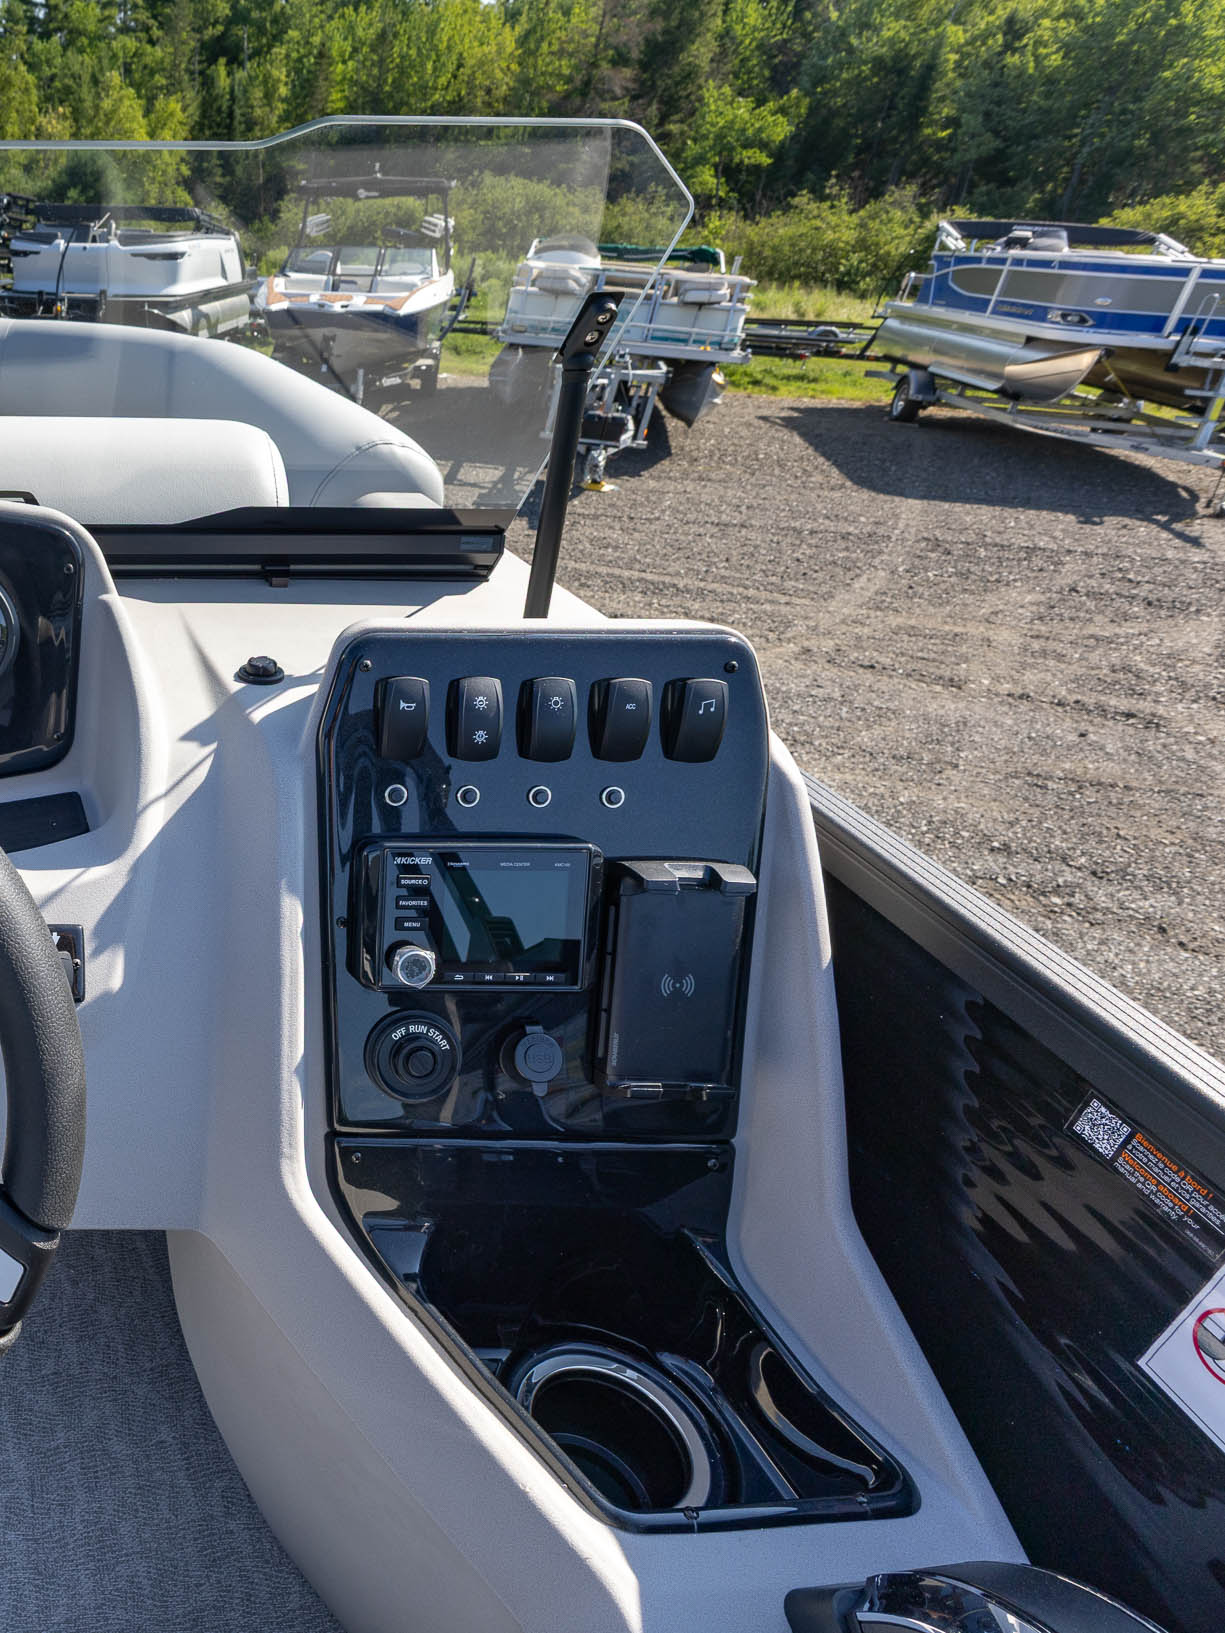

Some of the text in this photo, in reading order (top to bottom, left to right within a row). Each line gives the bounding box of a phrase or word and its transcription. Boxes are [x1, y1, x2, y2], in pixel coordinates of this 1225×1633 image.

[400, 856, 433, 865] KICKER
[391, 1024, 451, 1050] OFF RUN START
[1113, 1161, 1137, 1184] manual
[1136, 1182, 1150, 1195] and
[1120, 1151, 1158, 1185] Welcome
[1157, 1183, 1189, 1212] aboard
[1130, 1138, 1159, 1163] Scannez
[1163, 1166, 1181, 1183] code
[1179, 1180, 1194, 1193] QR
[1190, 1190, 1209, 1206] pour
[1131, 1148, 1148, 1163] votre
[1147, 1161, 1171, 1183] manuel
[1177, 1187, 1190, 1199] vos
[1135, 1132, 1179, 1172] Bienvenue
[1185, 1175, 1209, 1196] bord
[1117, 1156, 1200, 1230] Scan the QR code for your
